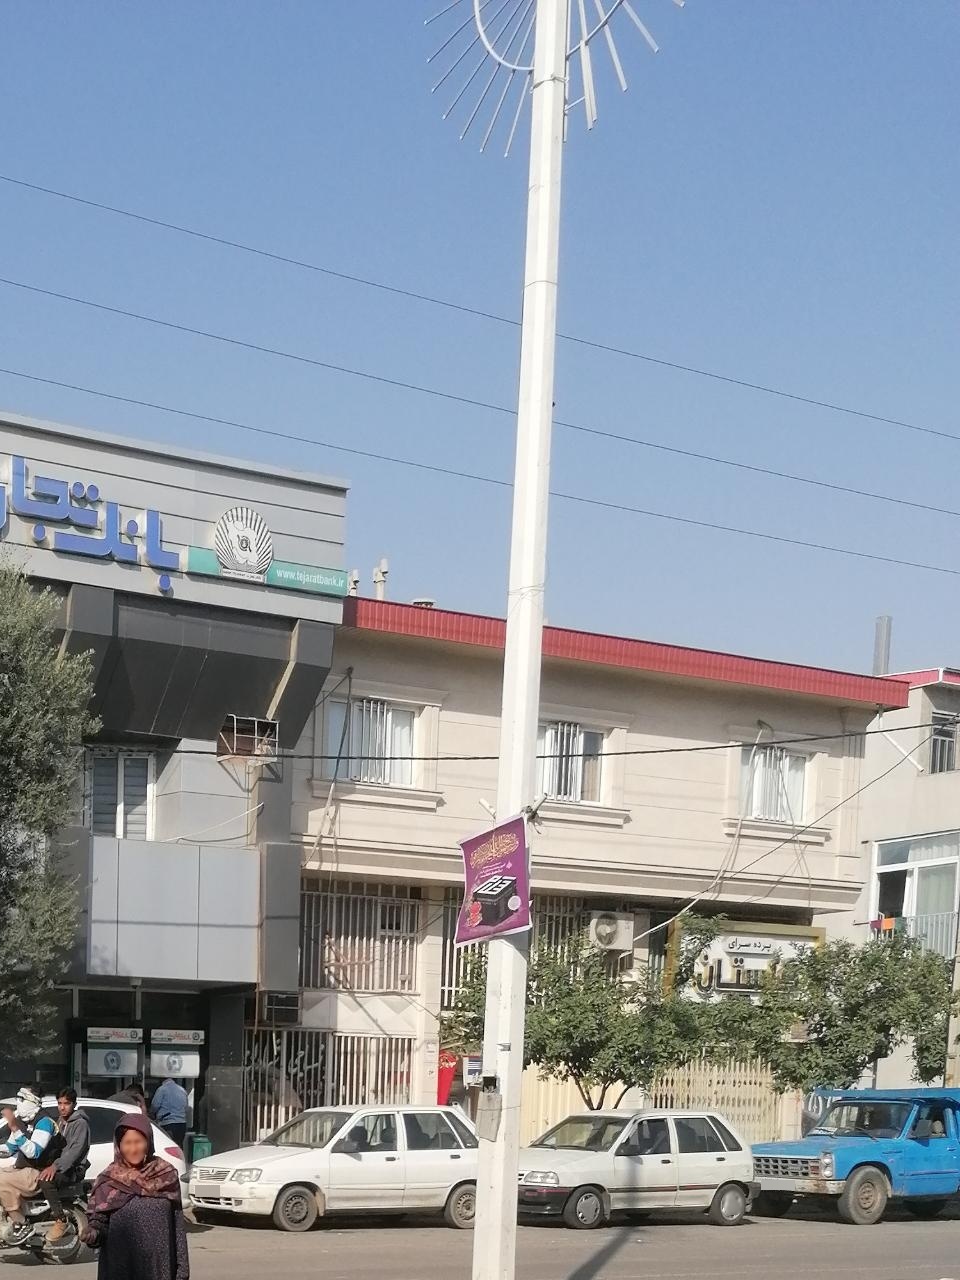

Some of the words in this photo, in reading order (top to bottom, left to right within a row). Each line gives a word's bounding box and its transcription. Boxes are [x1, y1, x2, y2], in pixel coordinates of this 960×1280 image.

[50, 502, 184, 594] بانک
[275, 568, 345, 588] www.tejaratbank.ir
[728, 937, 751, 951] سرای
[752, 941, 772, 952] پرده
